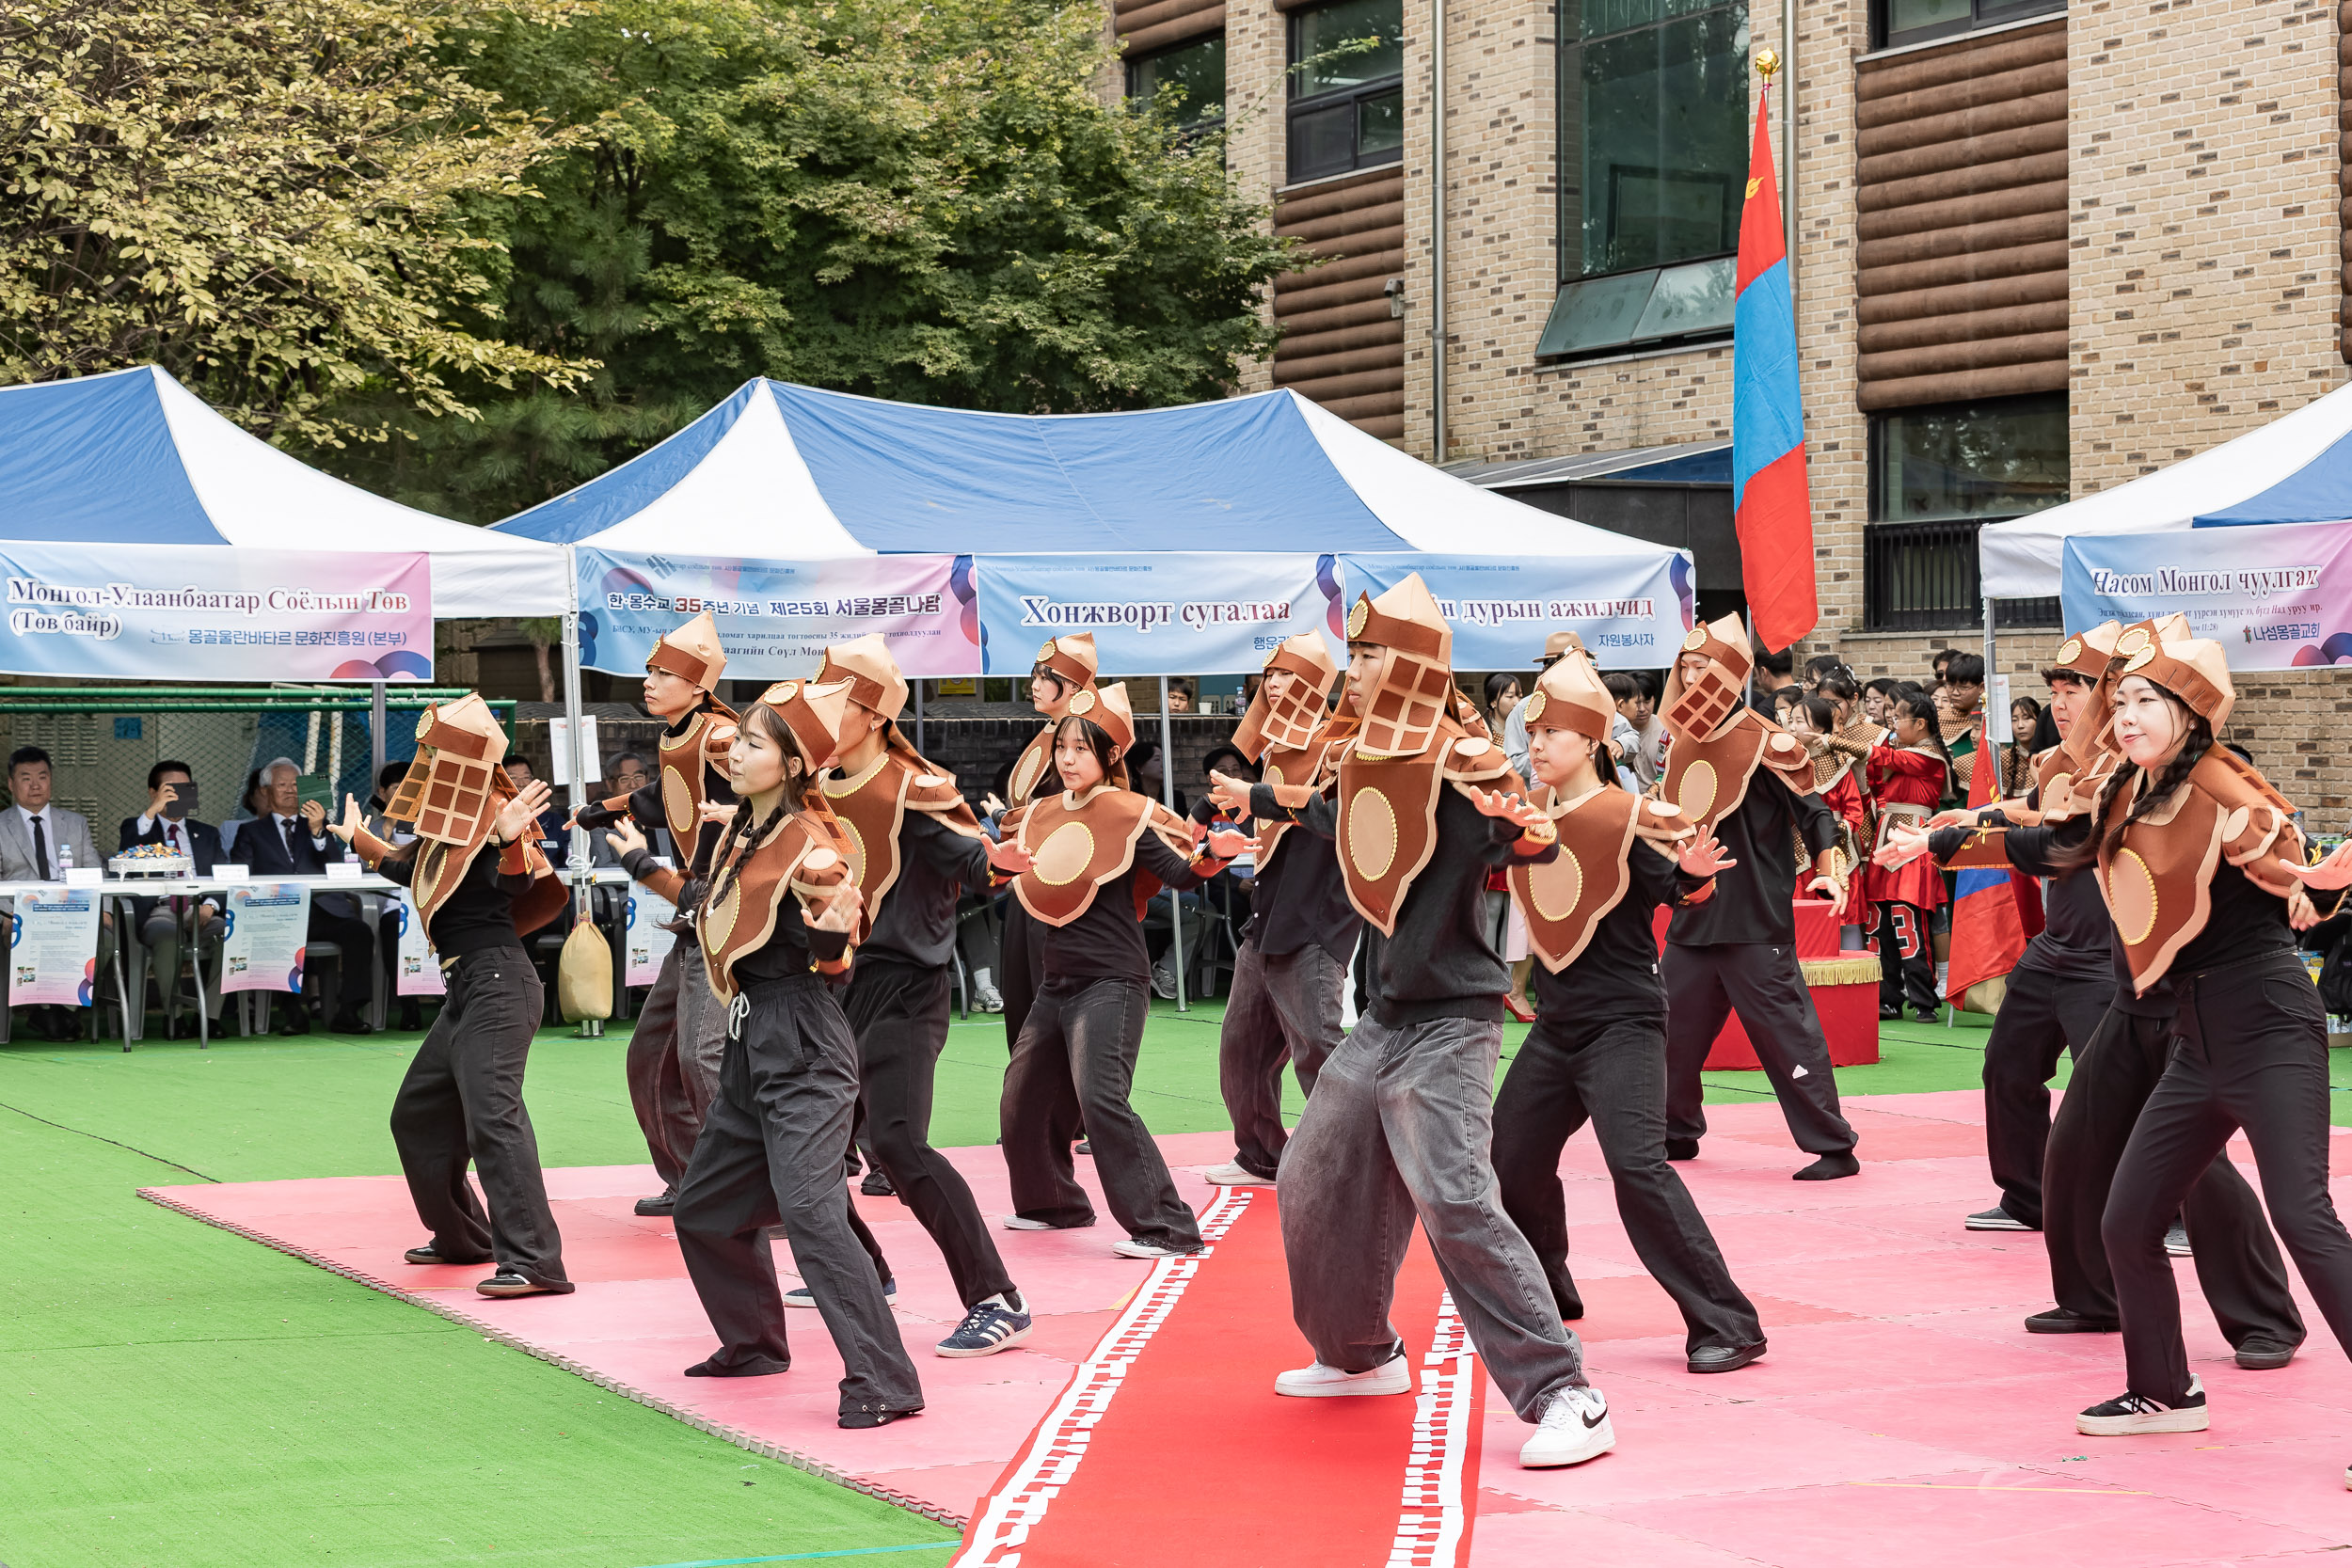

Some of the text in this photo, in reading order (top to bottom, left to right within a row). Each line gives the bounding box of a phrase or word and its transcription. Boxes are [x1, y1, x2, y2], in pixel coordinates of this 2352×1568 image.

[2160, 569, 2231, 592] Монгол
[2239, 569, 2318, 595] чуулган
[11, 580, 407, 614] Монгол-Улаанбаатар Соёлын Төв
[675, 597, 729, 614] 35주년
[734, 603, 759, 615] 기념
[770, 601, 829, 616] 제25회
[836, 594, 941, 616] 서울몽골나담
[13, 611, 119, 637] (Төв байр)
[1024, 598, 1290, 630] Хонжворт сугалаа
[1464, 602, 1541, 624] дурын
[1551, 598, 1654, 619] ажилчид
[188, 629, 407, 646] 몽골울란바타르 문화진흥원 (본부)
[1598, 633, 1655, 647] 자원봉사자
[2253, 622, 2321, 641] 나섬몽골교회
[1890, 904, 1920, 959] 3
